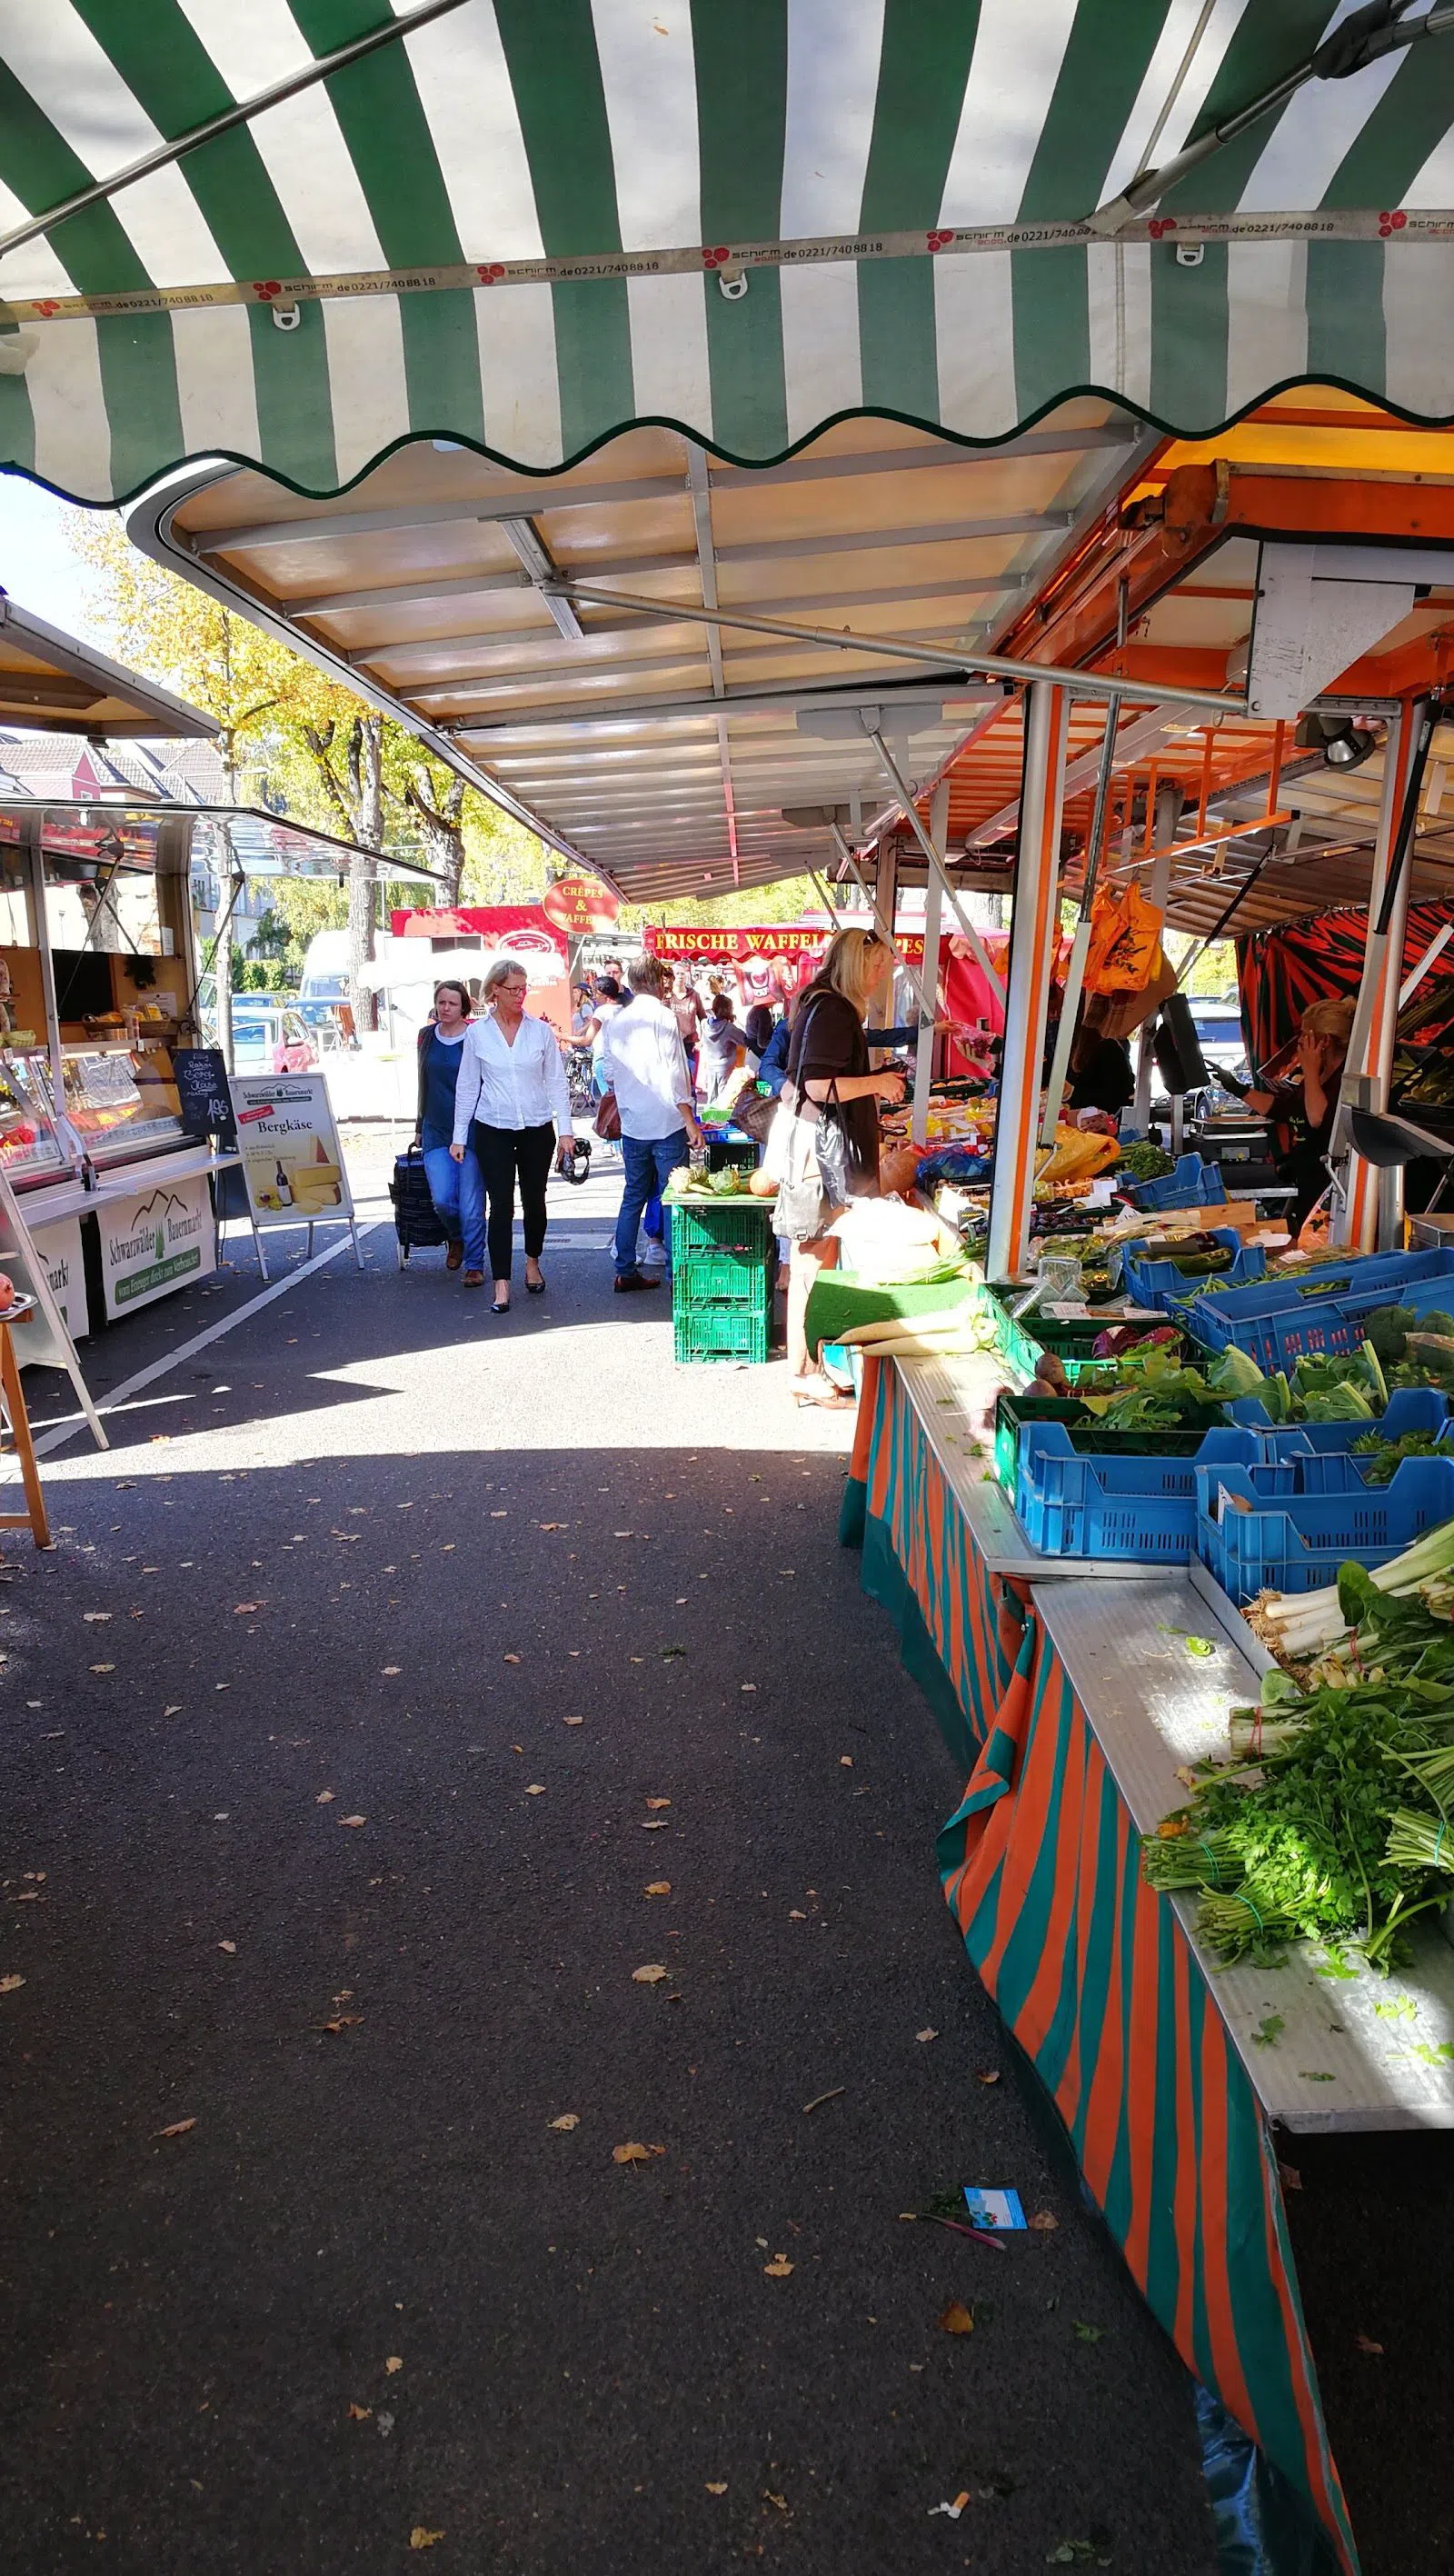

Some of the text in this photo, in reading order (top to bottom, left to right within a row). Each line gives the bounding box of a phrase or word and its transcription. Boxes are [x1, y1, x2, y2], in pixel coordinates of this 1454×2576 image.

[575, 899, 588, 912] &
[655, 934, 739, 951] FRISCHE
[258, 1119, 314, 1135] Bergkäse
[110, 1206, 202, 1266] Schwarzwälder Bauernmarkt
